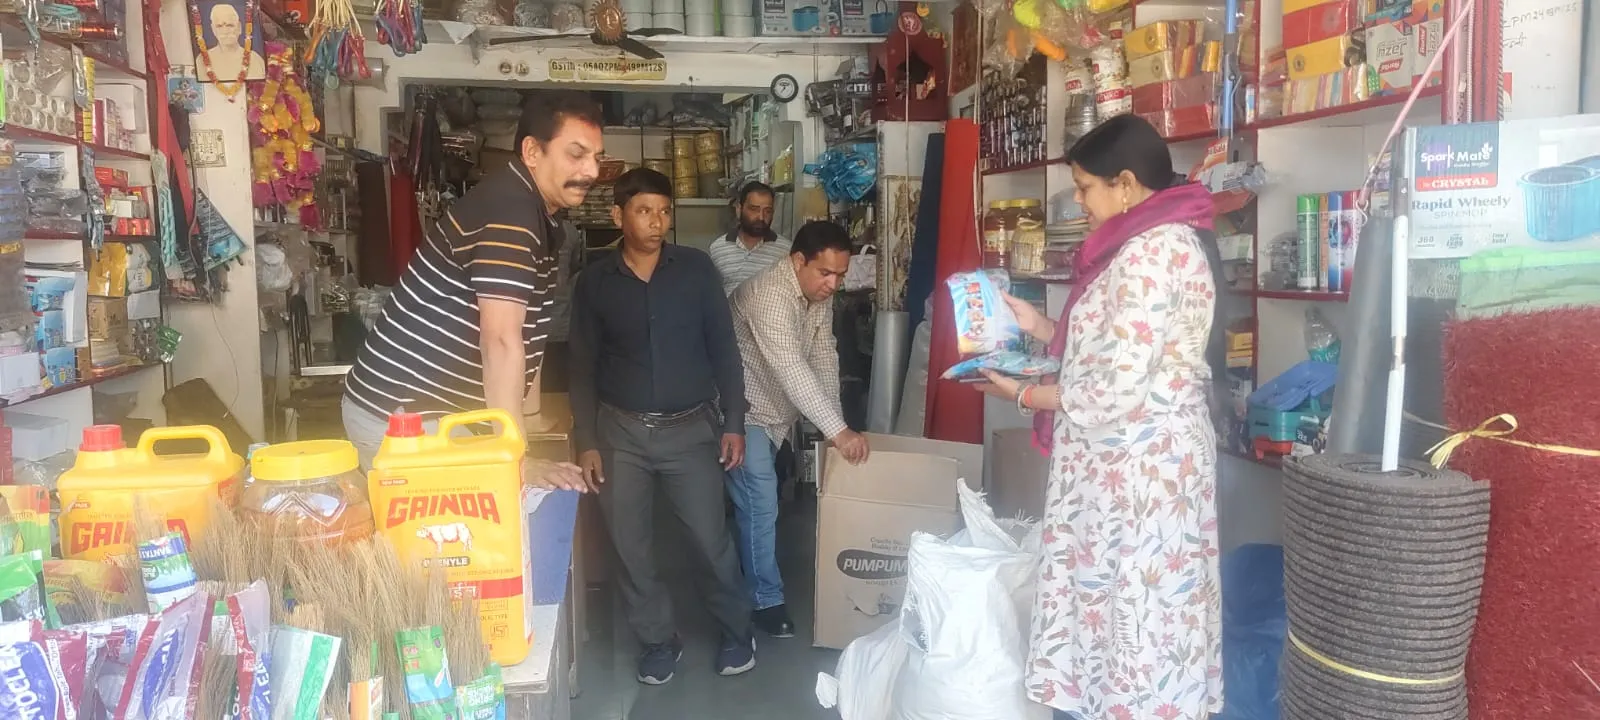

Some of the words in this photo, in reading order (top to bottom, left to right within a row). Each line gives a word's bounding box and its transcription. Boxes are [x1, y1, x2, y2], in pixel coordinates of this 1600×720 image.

[1420, 144, 1455, 171] Spark
[1456, 150, 1492, 163] Mate
[1431, 178, 1489, 189] CRYSTAL
[1411, 198, 1452, 212] Rapid
[1457, 195, 1512, 208] Wheely
[385, 492, 501, 529] GAINDA
[70, 518, 192, 555] GAIA
[423, 557, 469, 568] PENYLE
